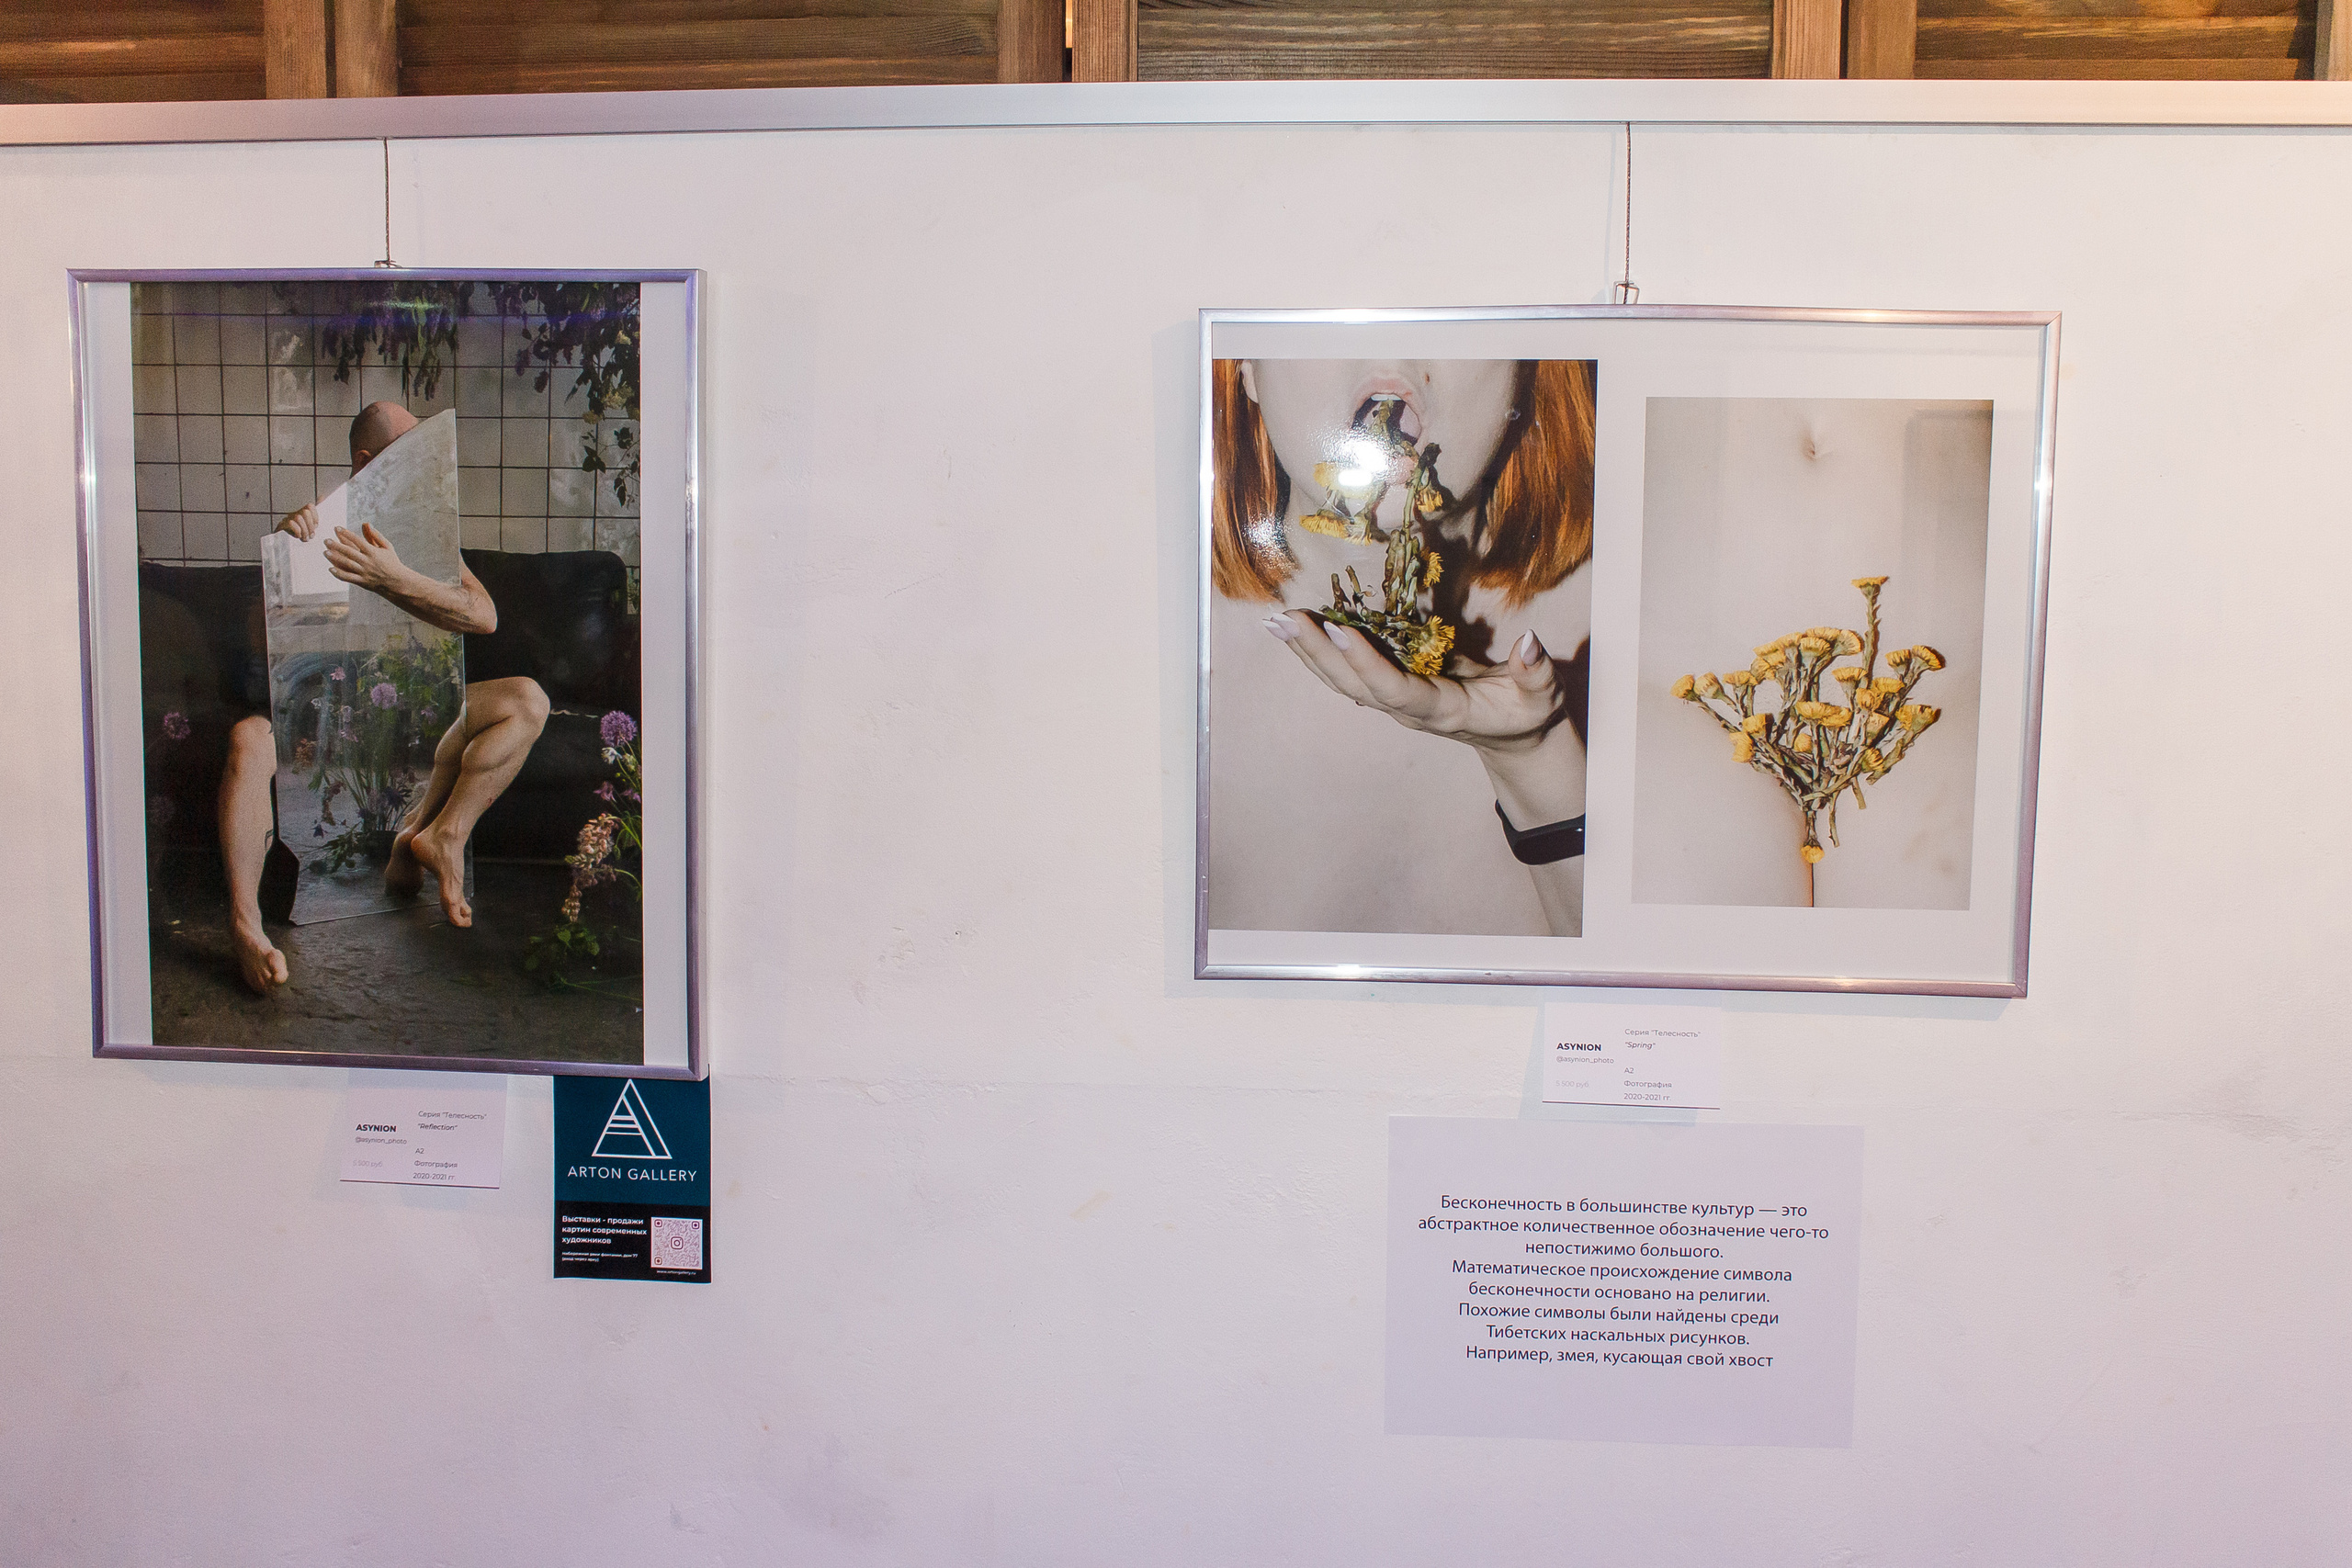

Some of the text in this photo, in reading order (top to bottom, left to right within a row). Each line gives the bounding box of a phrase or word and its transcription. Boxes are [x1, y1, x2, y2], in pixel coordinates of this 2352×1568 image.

[1651, 1030, 1701, 1038] "Телесность"
[1556, 1043, 1601, 1052] ASYNION
[1625, 1042, 1656, 1050] "Spring"
[1556, 1055, 1614, 1064] @asynion_photo
[1623, 1080, 1672, 1089] Фотография
[414, 1160, 458, 1168] Фотография
[568, 1167, 696, 1182] ARTON GALLERY
[1441, 1194, 1562, 1213] Бесконечность
[1566, 1201, 1575, 1212] в
[1579, 1197, 1687, 1216] большинстве
[1691, 1201, 1755, 1219] культур
[1781, 1204, 1807, 1217] это
[1418, 1216, 1828, 1241] абстрактное количественное обозначение чего-то
[1525, 1242, 1724, 1259] непостижимо большого.
[1452, 1259, 1792, 1283] Математическое происхождение символа
[1468, 1281, 1770, 1305] бесконечности основано на религии.
[1458, 1303, 1779, 1327] Похожие символы были найдены среди
[1487, 1325, 1750, 1348] Тибетских наскальных рисунков.
[1466, 1347, 1773, 1368] Например, змея, кусающая свой хвост
